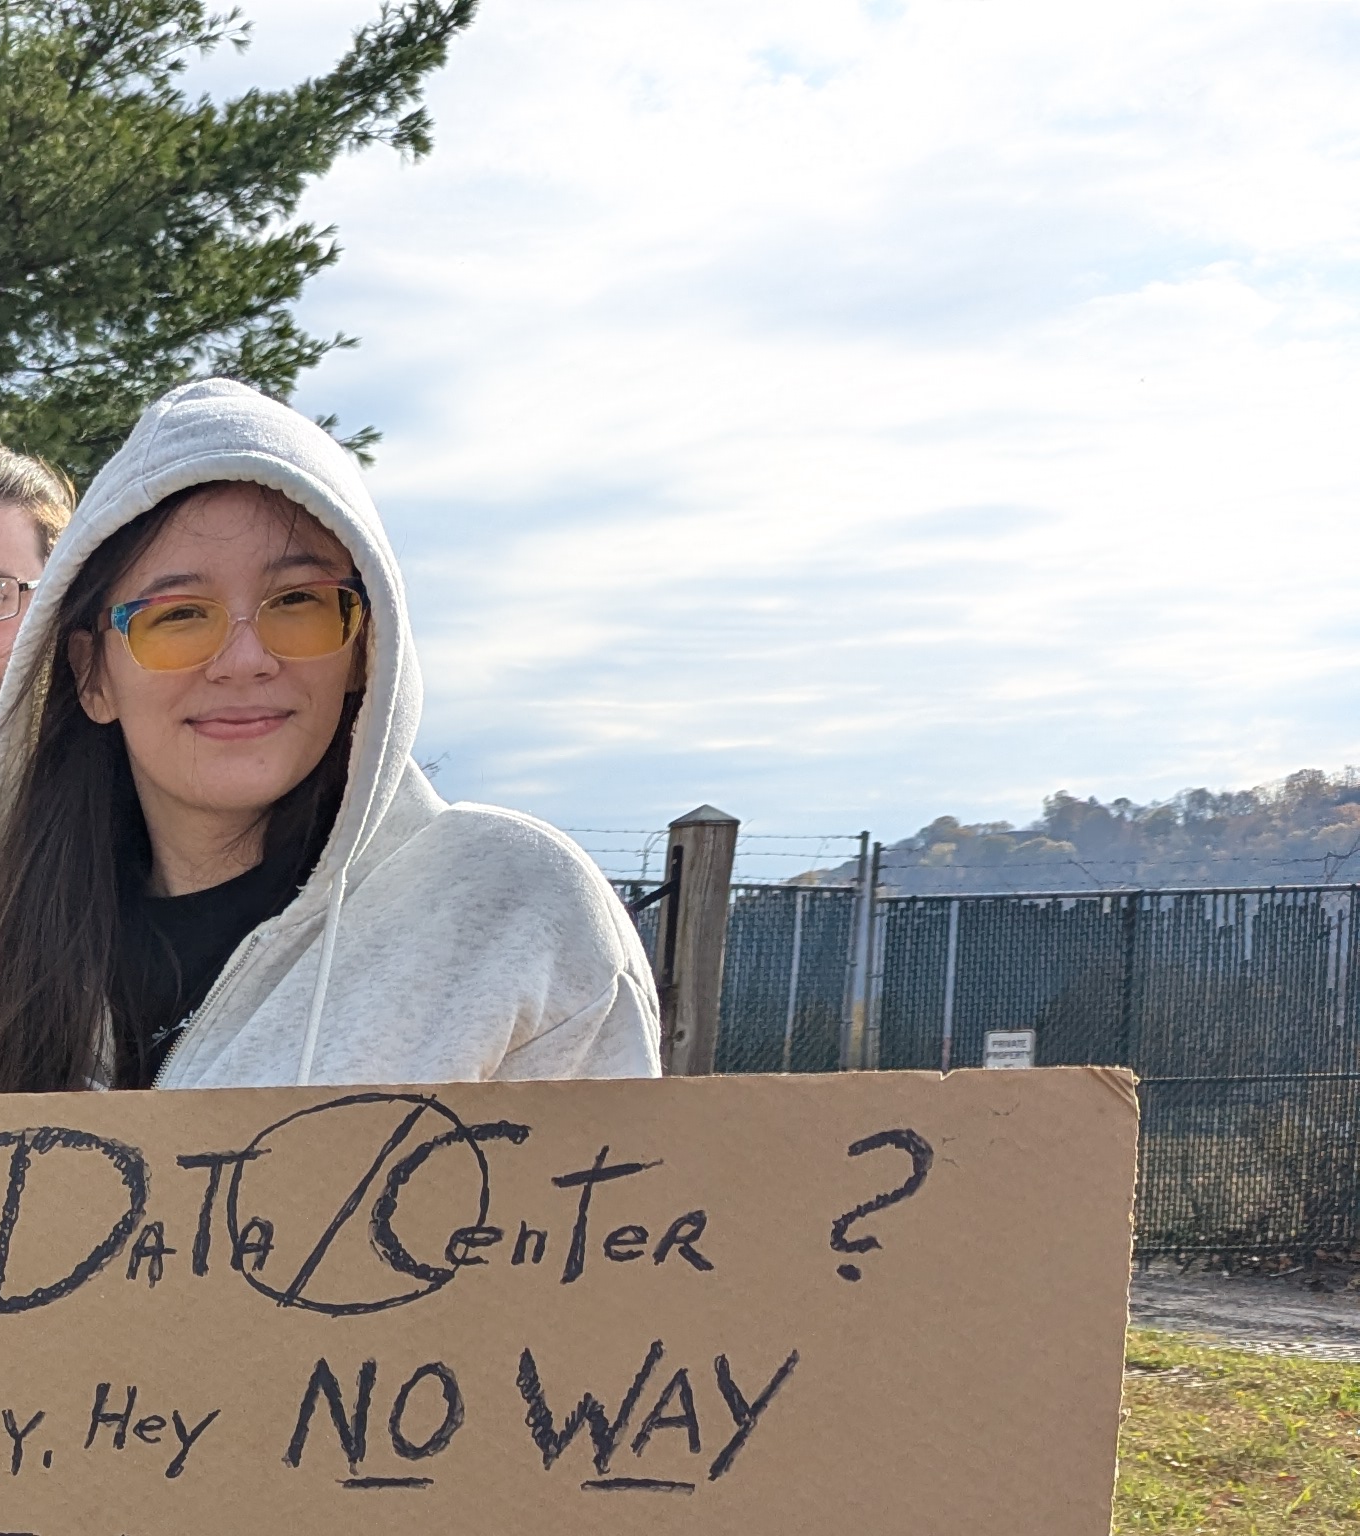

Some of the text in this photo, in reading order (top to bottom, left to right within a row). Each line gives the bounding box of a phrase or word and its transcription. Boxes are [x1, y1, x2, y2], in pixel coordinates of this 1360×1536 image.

[83, 1382, 222, 1479] Hey
[282, 1356, 466, 1490] NO
[516, 1338, 800, 1492] WAY
